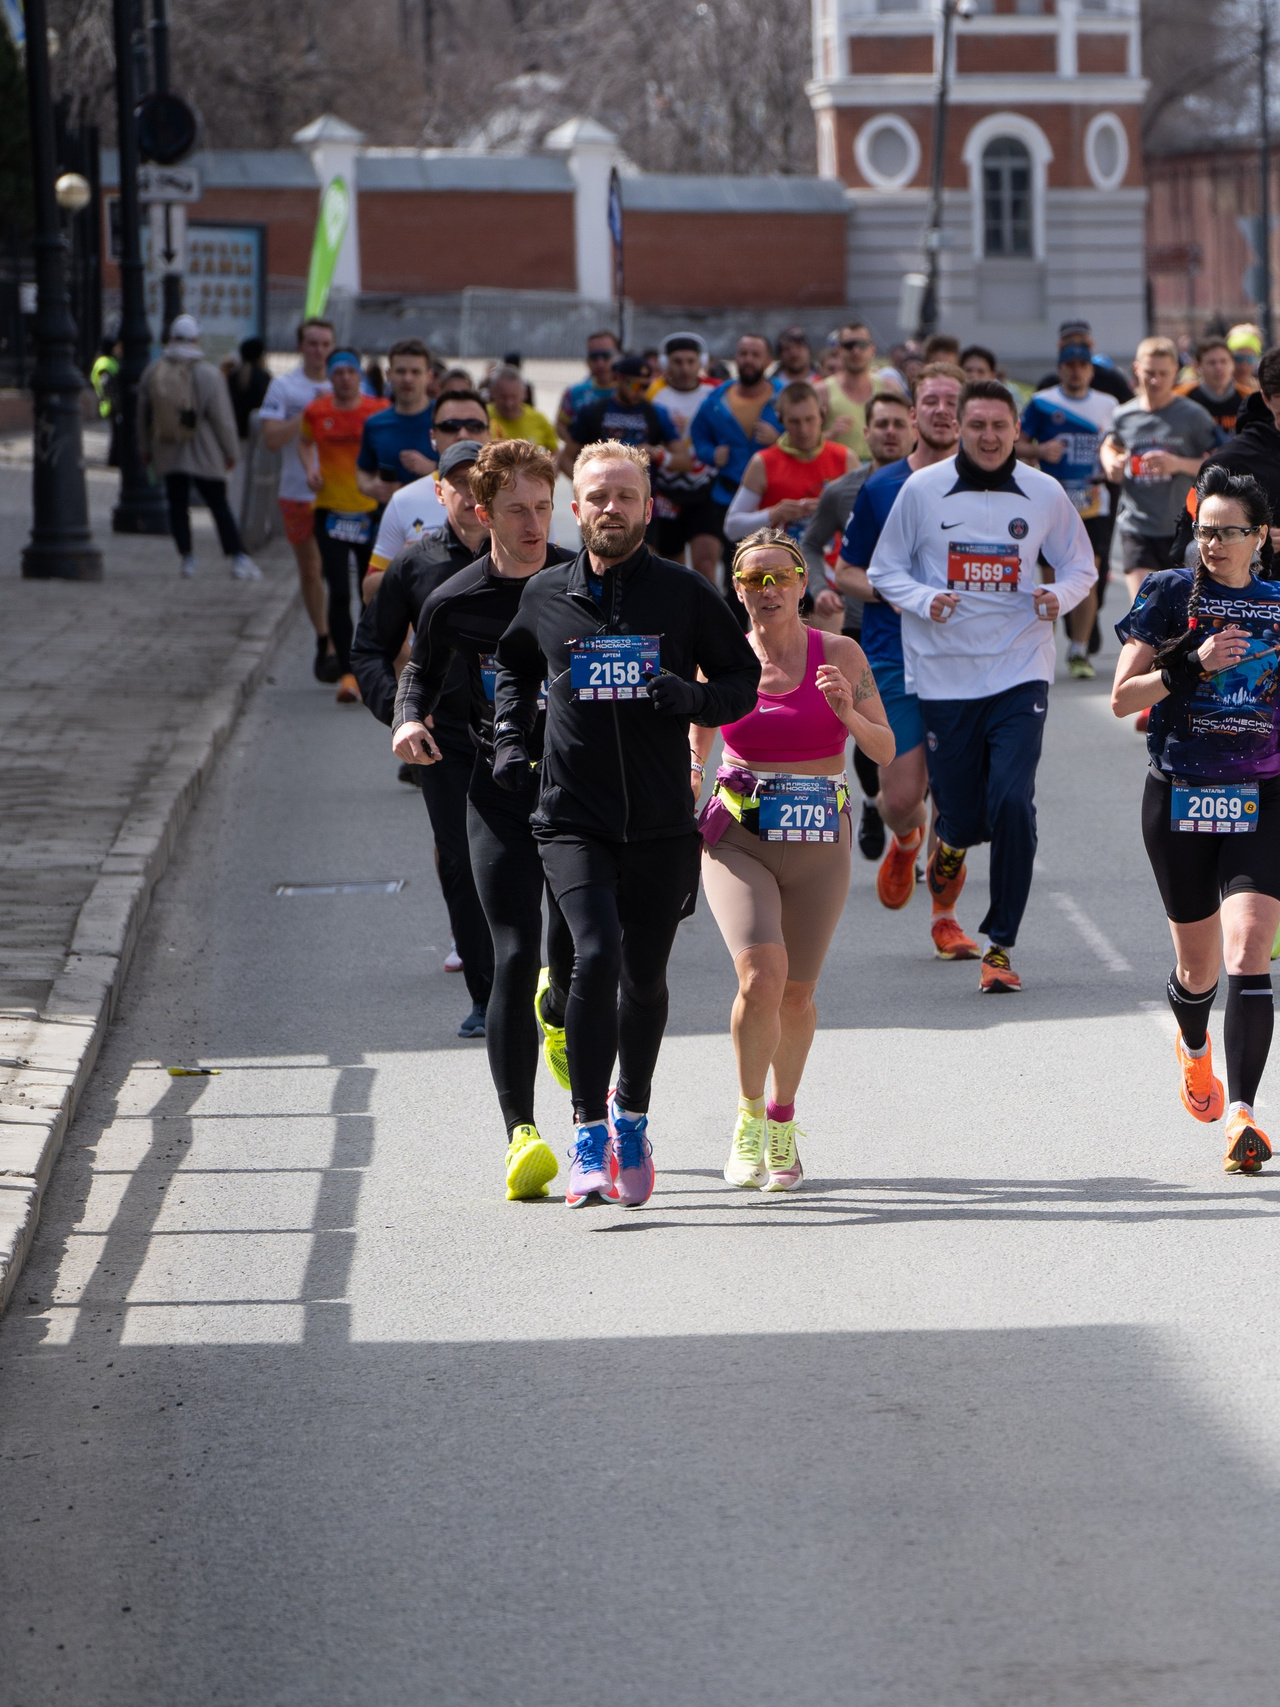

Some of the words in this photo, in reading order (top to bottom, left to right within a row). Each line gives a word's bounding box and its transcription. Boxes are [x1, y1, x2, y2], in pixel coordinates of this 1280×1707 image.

[963, 562, 1003, 581] 1569
[589, 661, 640, 685] 2158
[780, 804, 825, 828] 2179
[1188, 796, 1242, 820] 2069
